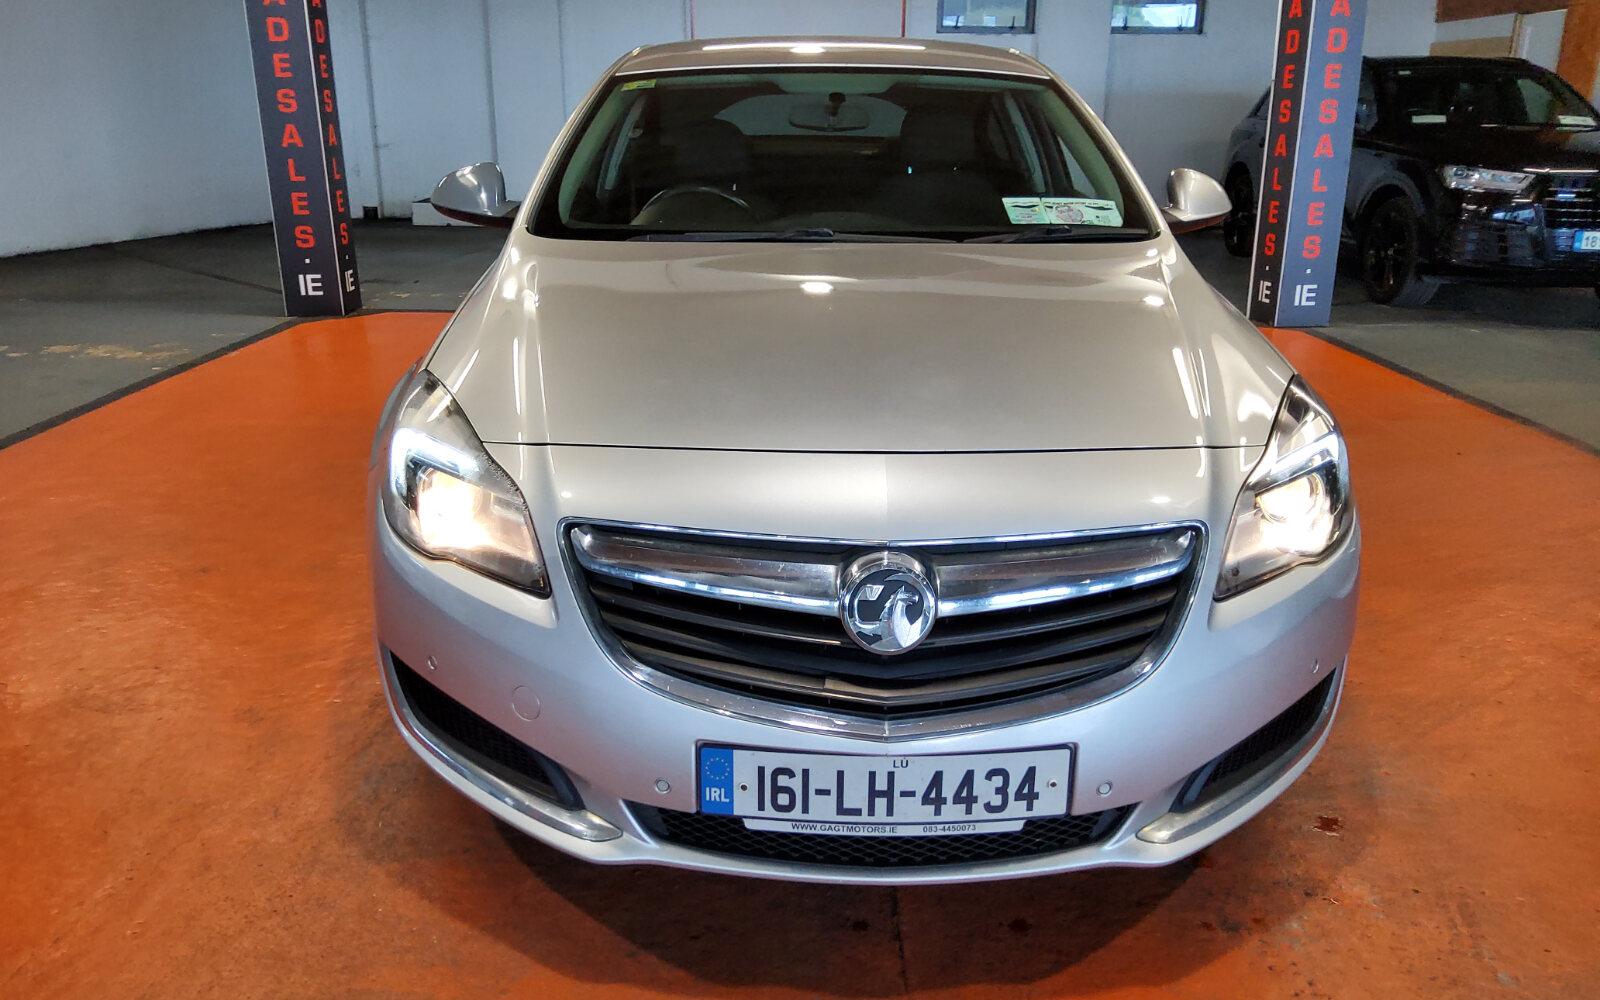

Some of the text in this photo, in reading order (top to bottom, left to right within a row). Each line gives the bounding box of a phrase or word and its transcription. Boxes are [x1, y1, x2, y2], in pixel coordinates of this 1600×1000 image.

[705, 787, 730, 803] IRL
[757, 765, 1039, 817] 161-LH-4434
[791, 823, 898, 834] WWW.GAGTMOTORS.IE
[922, 824, 977, 833] 083-4450073
